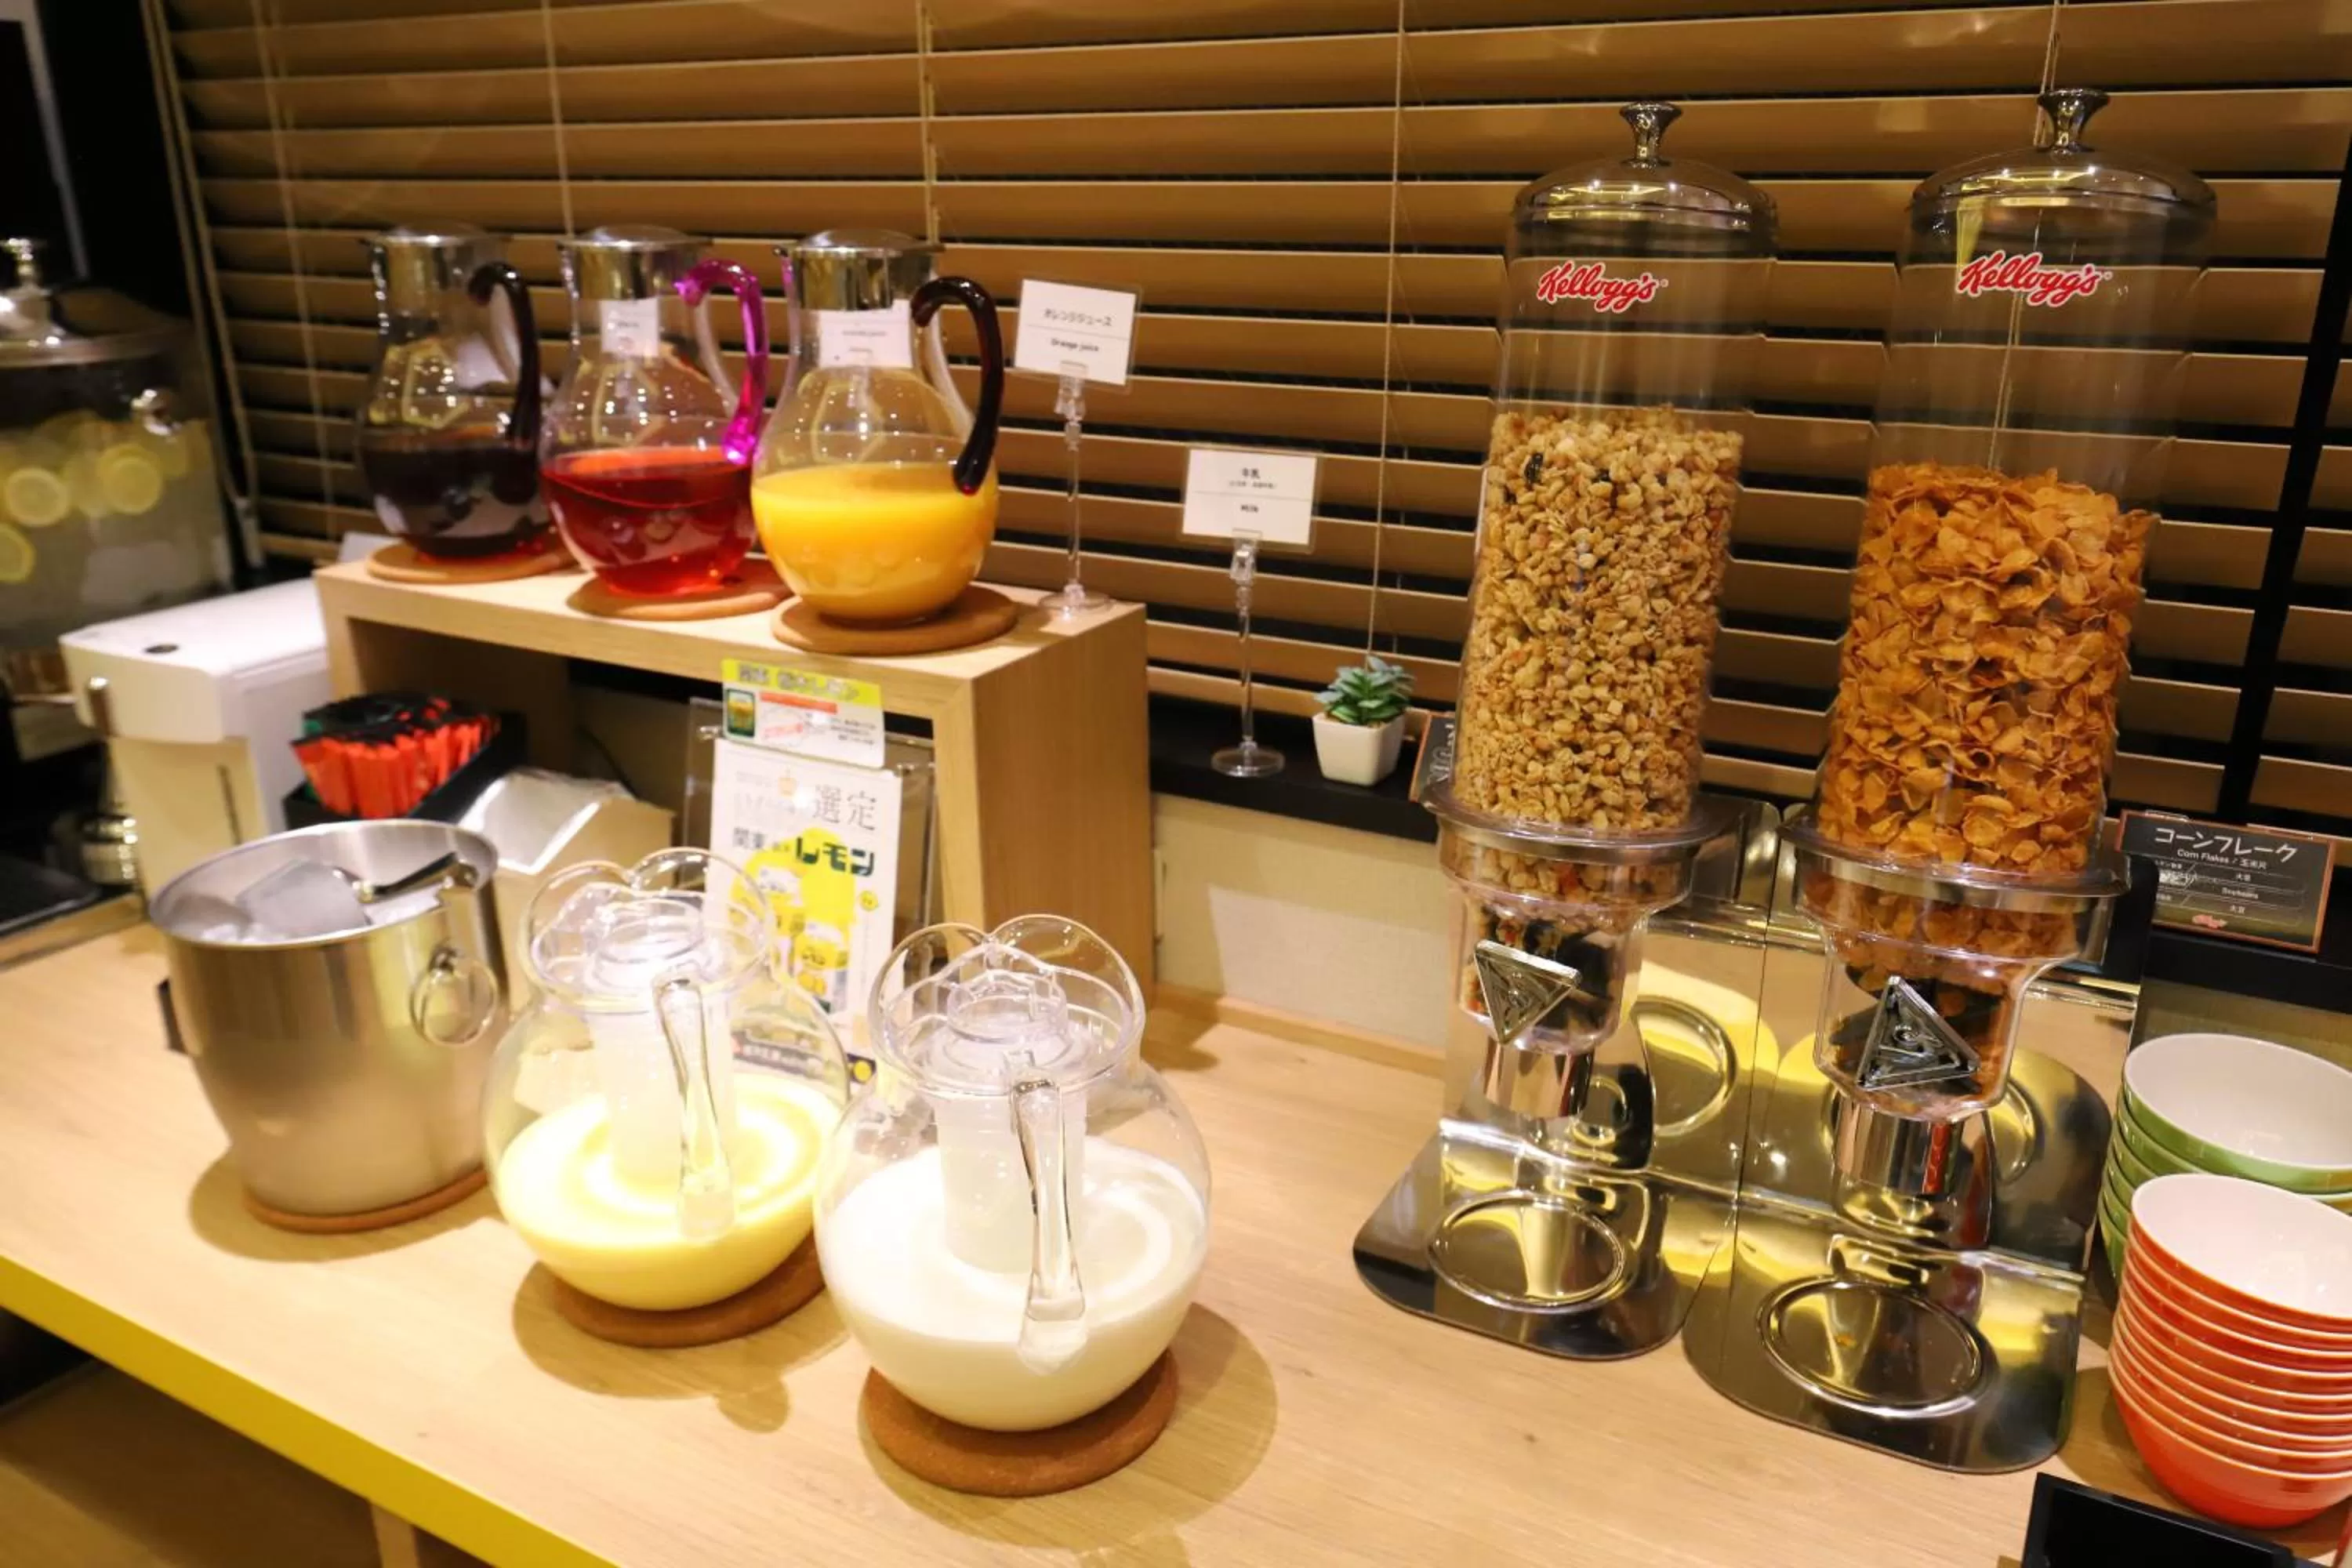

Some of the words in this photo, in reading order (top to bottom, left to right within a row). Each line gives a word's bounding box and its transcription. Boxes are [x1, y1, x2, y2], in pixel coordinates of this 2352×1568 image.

[1537, 260, 1658, 313] Kellogg's
[1956, 249, 2101, 307] Kellogg's
[2154, 827, 2298, 862] コーンフレーク
[2177, 848, 2199, 860] Corn
[2201, 851, 2229, 864] Flakes
